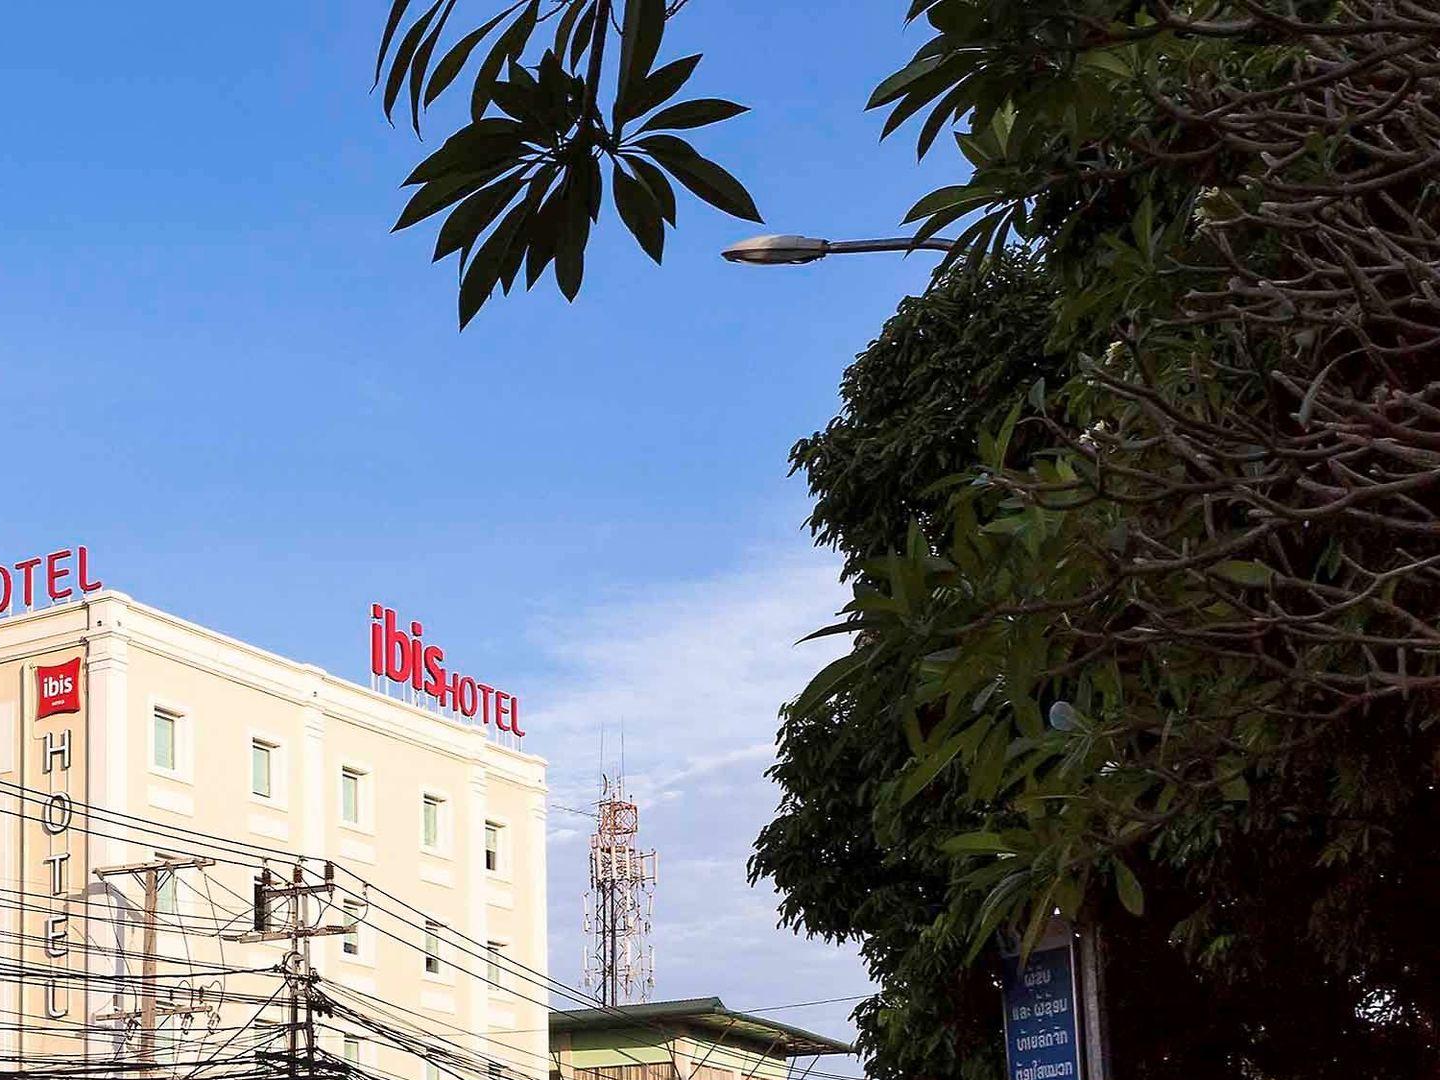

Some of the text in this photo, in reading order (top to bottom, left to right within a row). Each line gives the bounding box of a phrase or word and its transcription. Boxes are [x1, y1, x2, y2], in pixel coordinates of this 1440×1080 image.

[43, 673, 73, 699] ibis
[370, 605, 526, 738] ibis HOTEL
